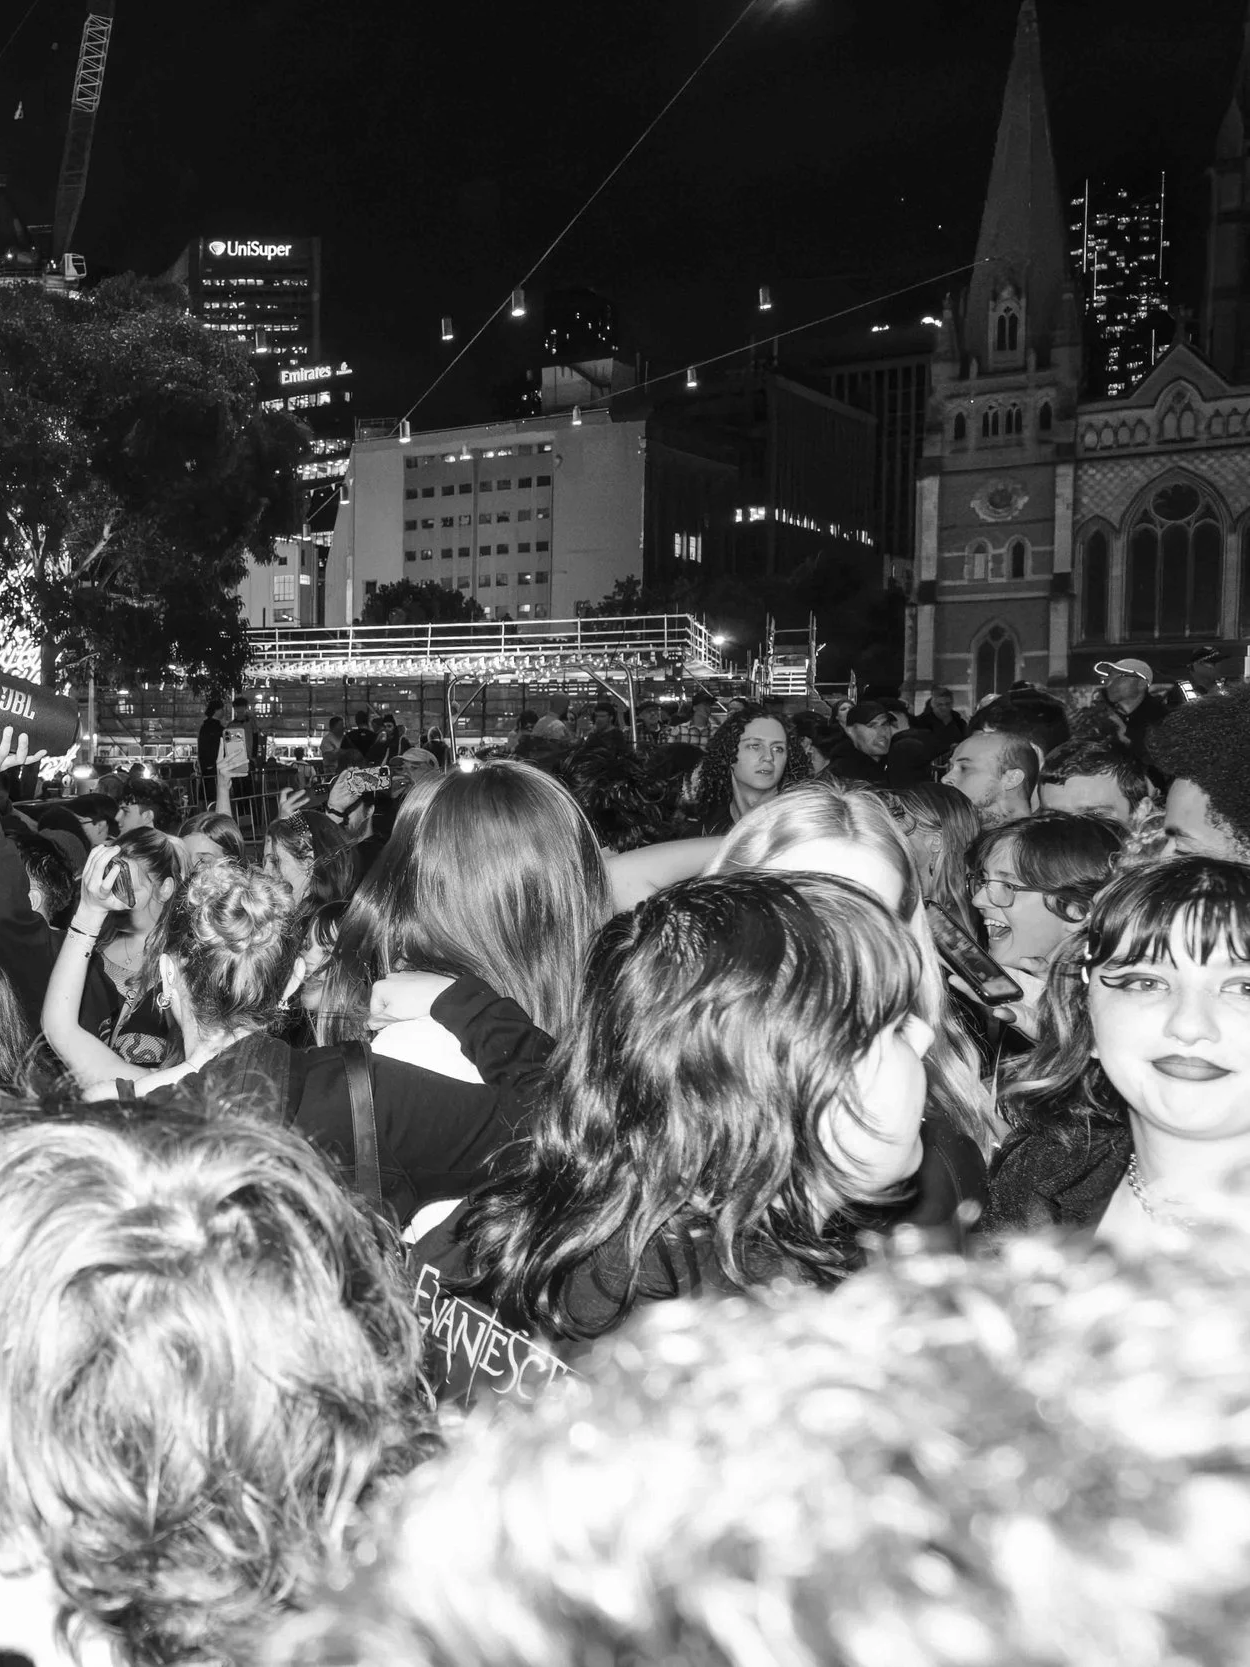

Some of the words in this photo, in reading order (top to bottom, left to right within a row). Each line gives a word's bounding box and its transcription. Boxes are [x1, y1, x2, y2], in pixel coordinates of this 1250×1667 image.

[227, 240, 292, 261] UniSuper
[280, 366, 331, 385] Emirates
[0, 686, 36, 720] JBL
